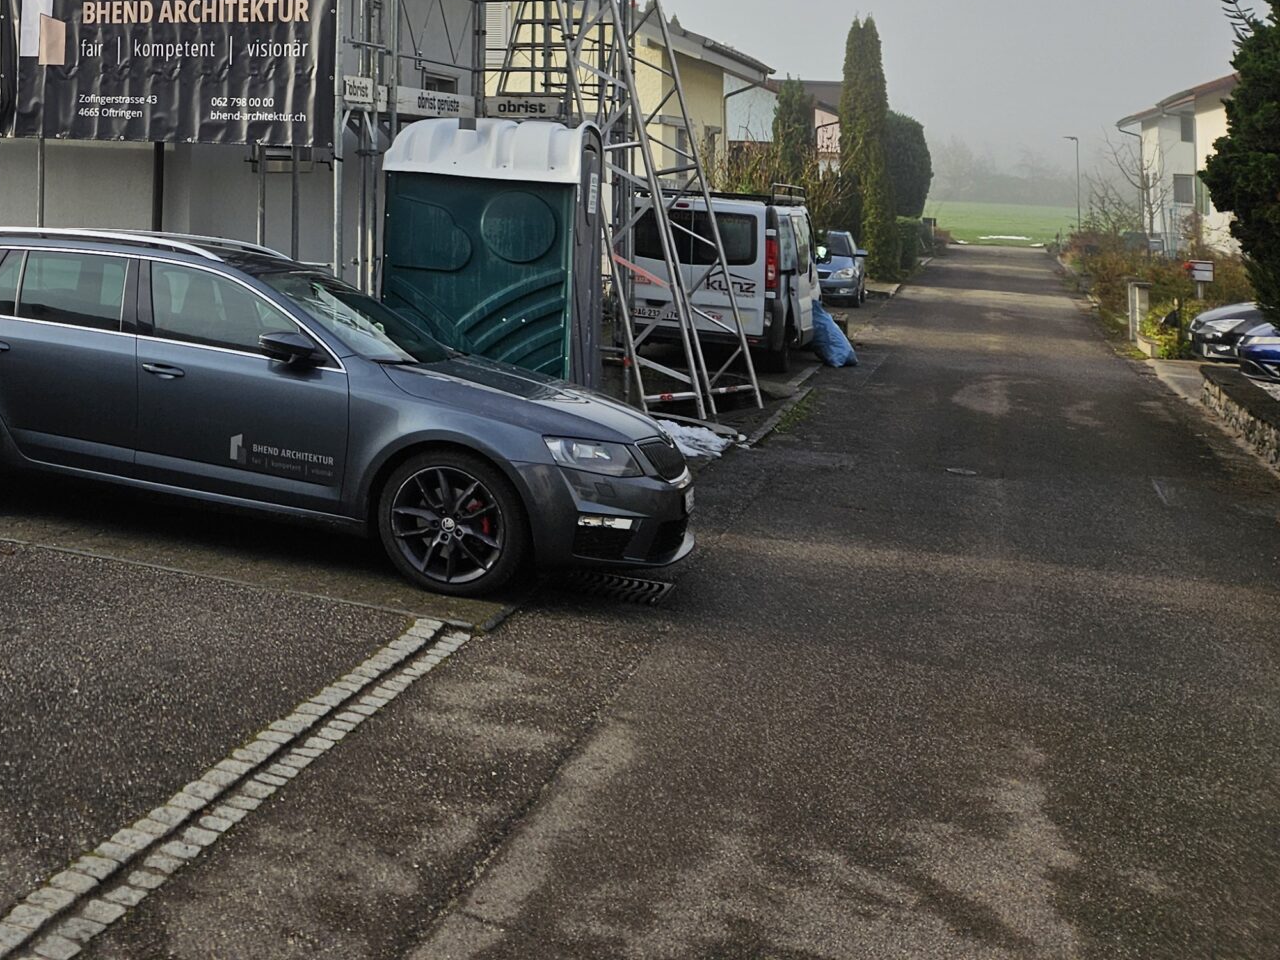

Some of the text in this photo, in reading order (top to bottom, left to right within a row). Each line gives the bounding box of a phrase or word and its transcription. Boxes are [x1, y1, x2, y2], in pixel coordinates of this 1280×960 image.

[82, 0, 154, 25] BHEND
[81, 39, 309, 62] fair kompetent visionär
[79, 94, 158, 106] Zofingerstrasse 43
[211, 97, 275, 107] 062 798 00 00
[498, 100, 546, 113] obrist
[78, 108, 143, 119] 4665 Oftringen
[210, 110, 307, 122] bhend-architektur.ch
[252, 444, 334, 466] BHEND ARCHITEKTUR
